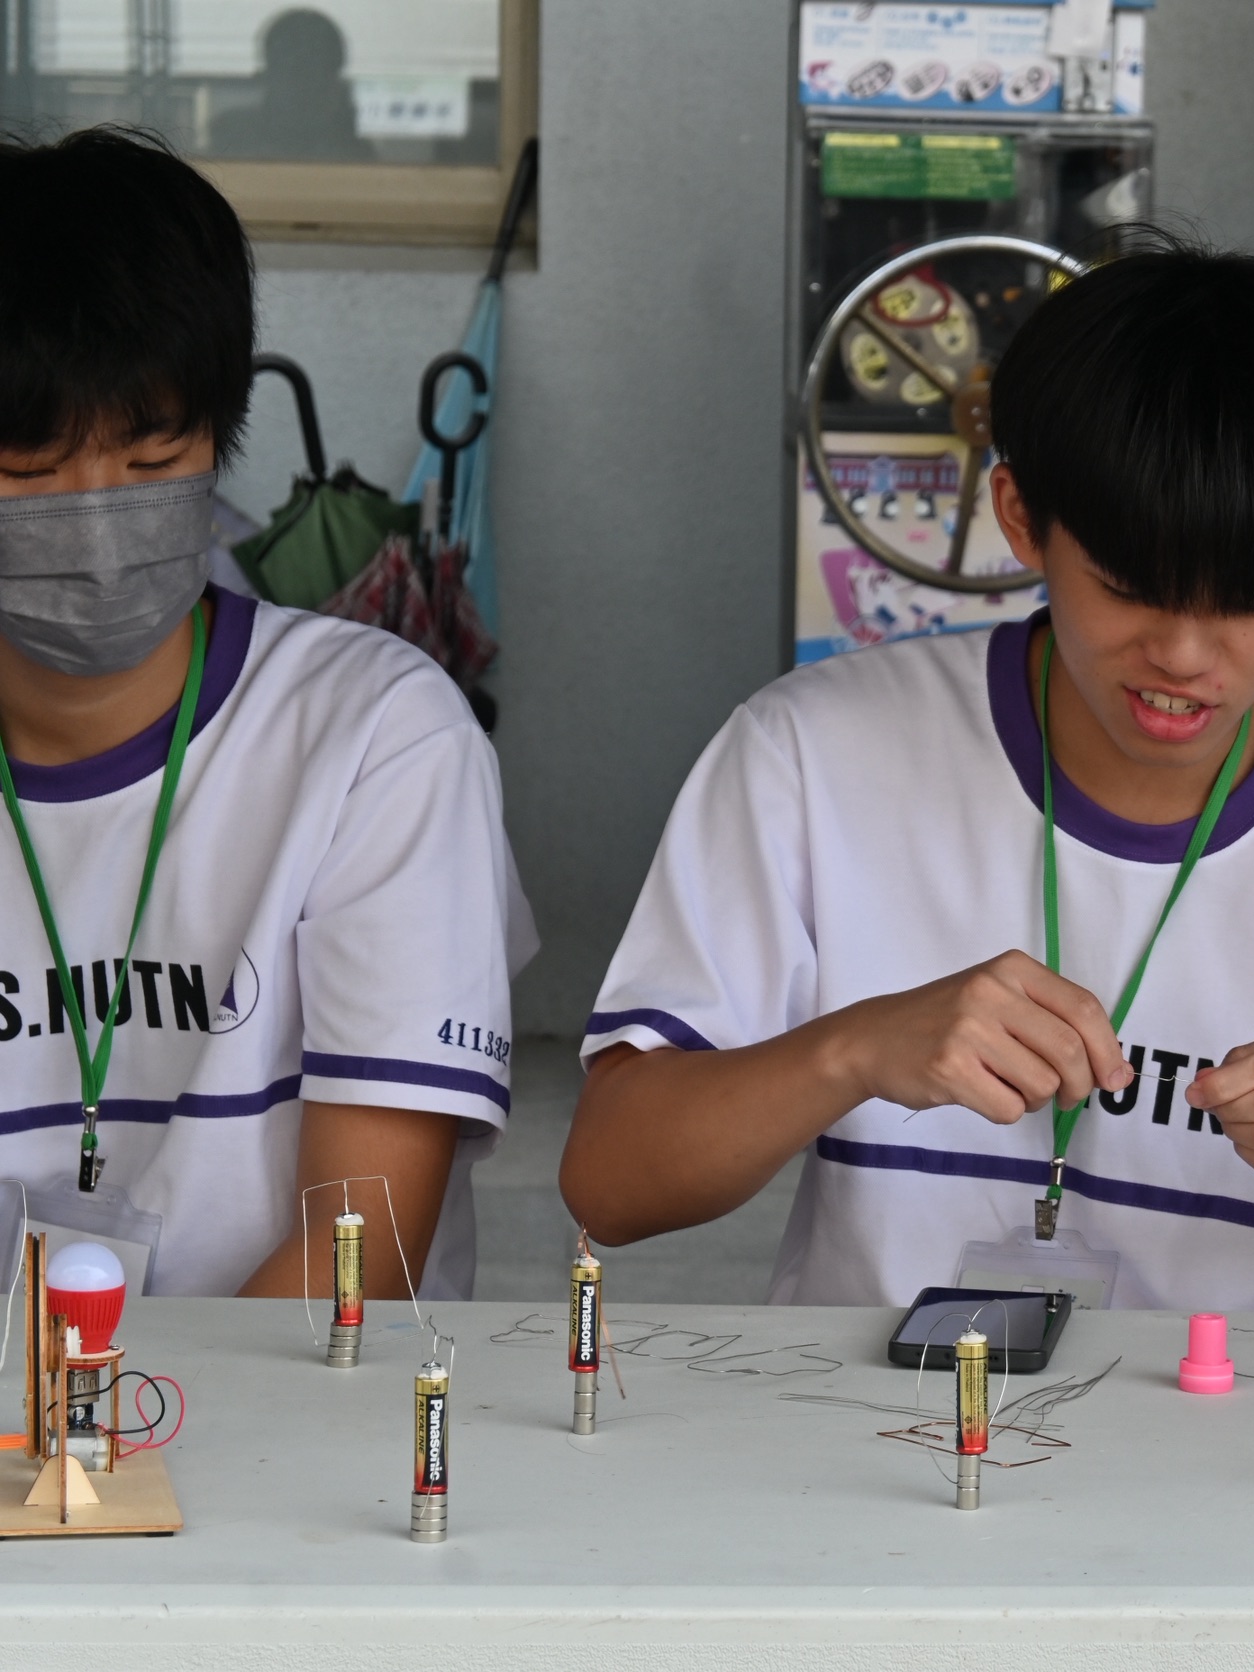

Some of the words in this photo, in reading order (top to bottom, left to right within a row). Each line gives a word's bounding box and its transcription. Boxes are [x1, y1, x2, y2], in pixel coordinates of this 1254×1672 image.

[437, 1018, 510, 1067] 411332
[580, 1285, 595, 1361] Panasonic
[429, 1398, 444, 1481] Panasonic
